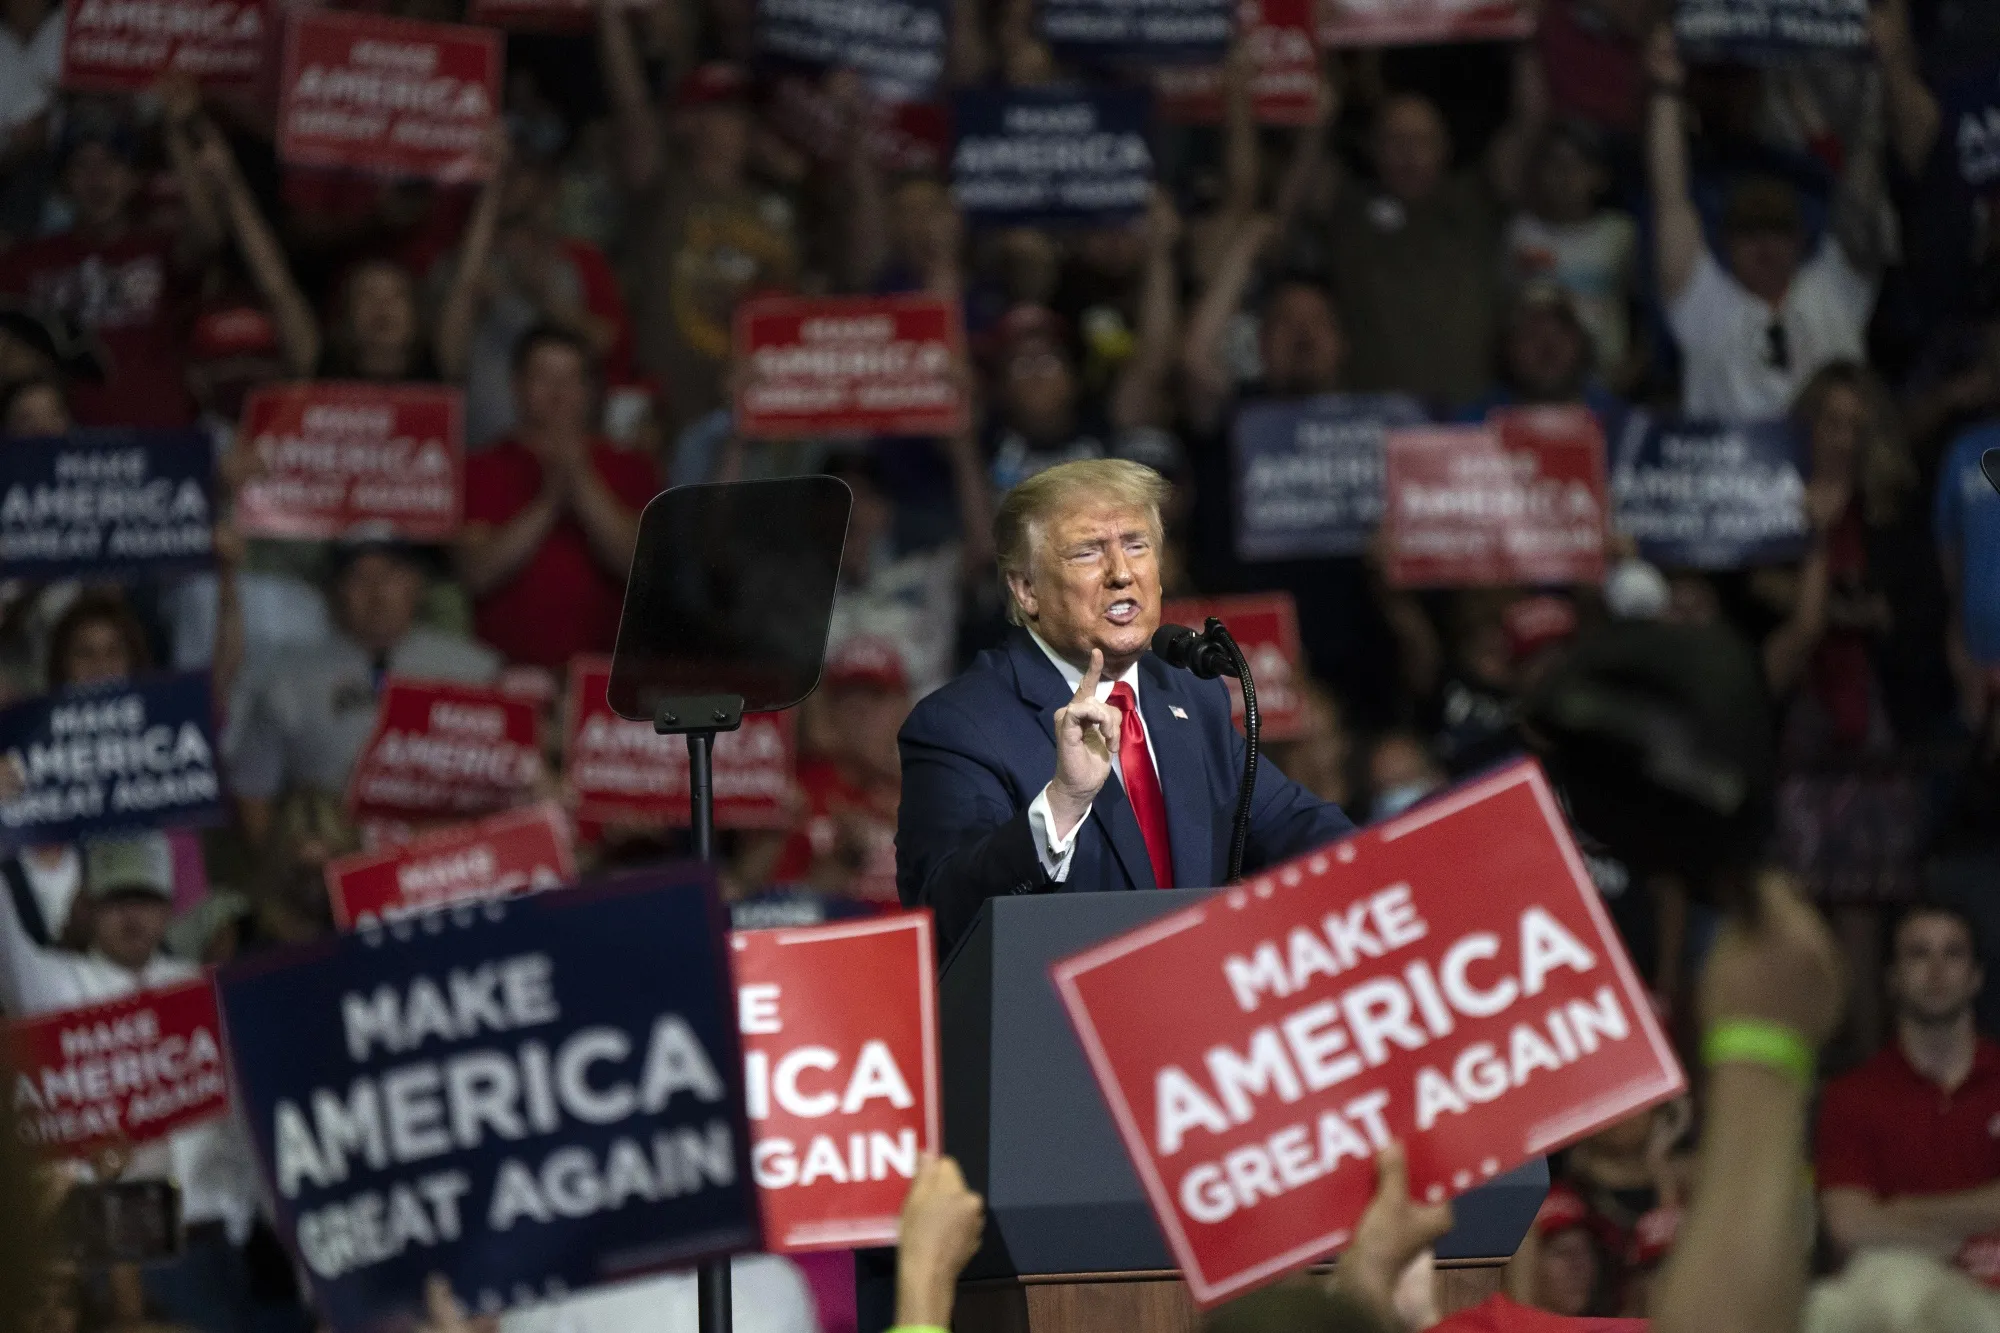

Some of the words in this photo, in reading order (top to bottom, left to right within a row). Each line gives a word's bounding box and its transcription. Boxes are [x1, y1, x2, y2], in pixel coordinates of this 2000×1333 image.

[1221, 880, 1431, 1012] MAKE
[58, 1007, 160, 1062] MAKE
[341, 951, 562, 1063] MAKE
[1154, 903, 1598, 1157] AMERICA
[13, 1024, 221, 1114] AMERICA
[273, 1011, 726, 1200] AMERICA
[1178, 1087, 1396, 1225] GREAT
[1414, 983, 1631, 1131] AGAIN
[486, 1116, 738, 1235] AGAIN
[751, 1127, 918, 1190] GAIN
